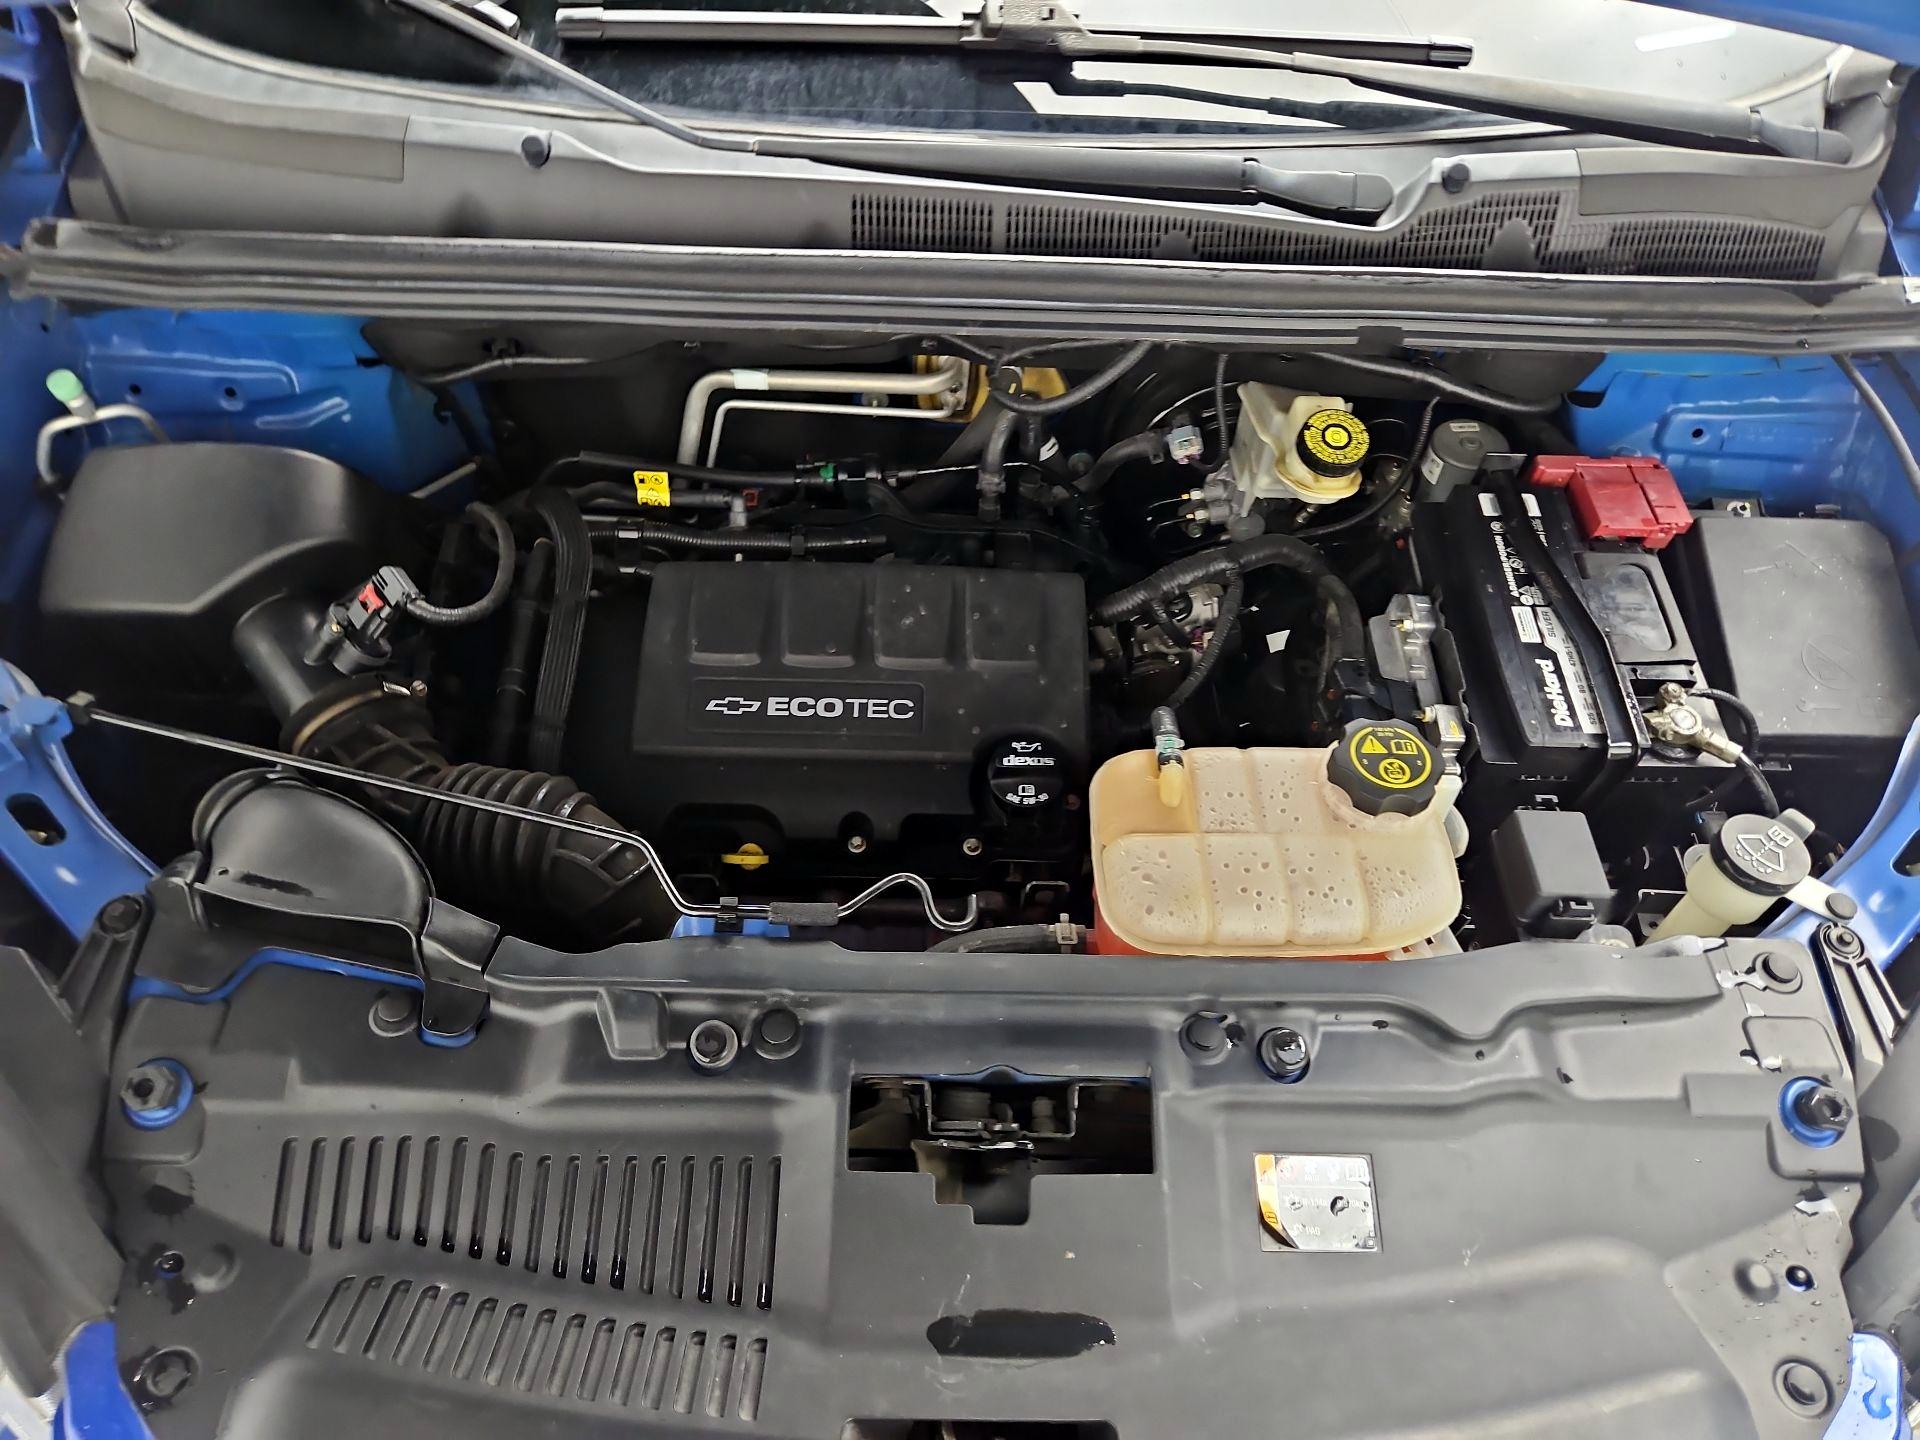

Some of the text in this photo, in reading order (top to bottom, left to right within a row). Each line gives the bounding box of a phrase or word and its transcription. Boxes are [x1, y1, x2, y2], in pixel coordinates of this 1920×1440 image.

[1547, 610, 1558, 638] SILVER
[1535, 658, 1574, 728] DieHard
[766, 696, 915, 720] ECOTEC
[1002, 754, 1056, 766] dexos
